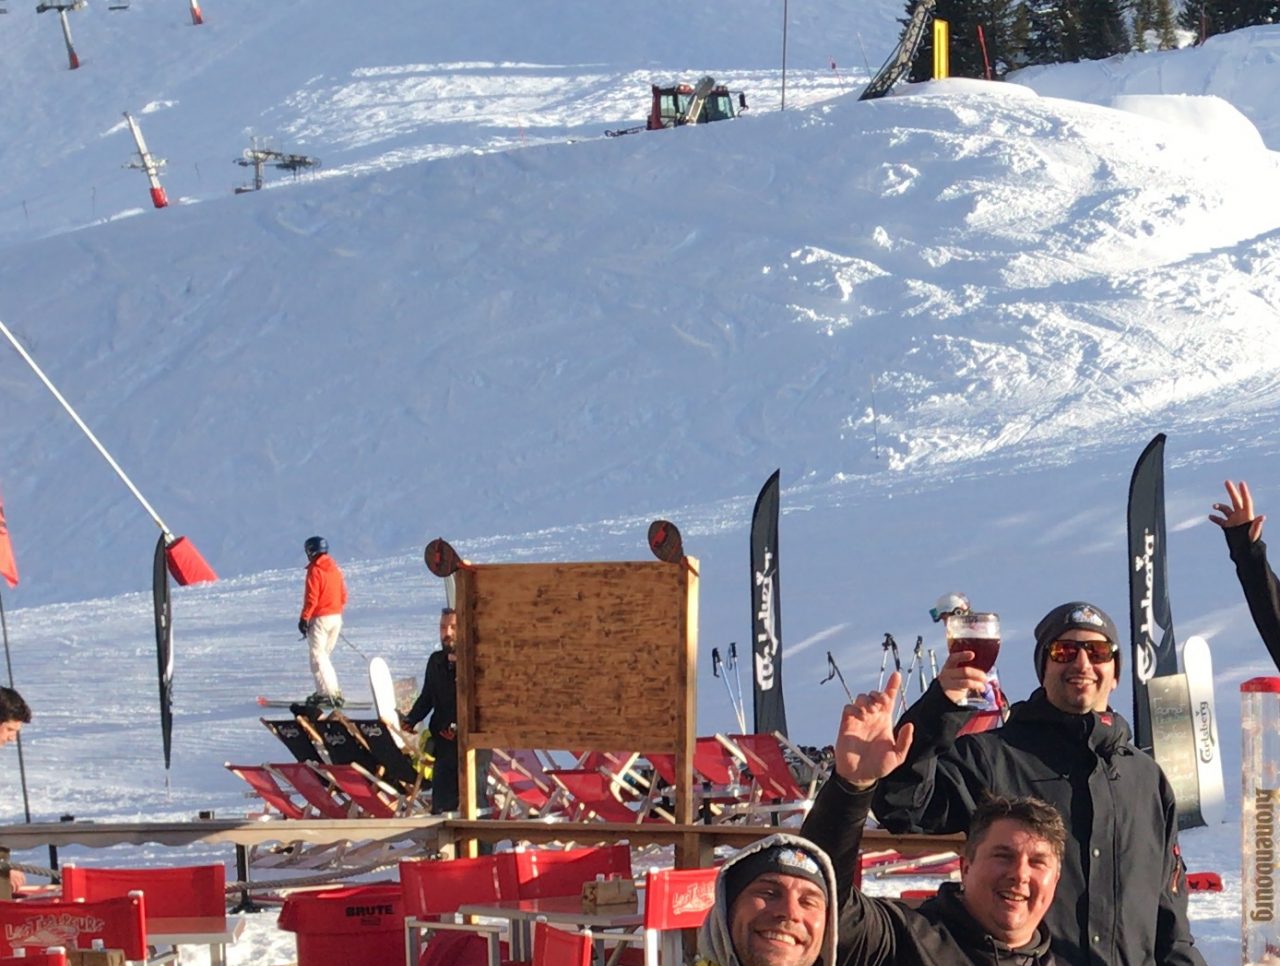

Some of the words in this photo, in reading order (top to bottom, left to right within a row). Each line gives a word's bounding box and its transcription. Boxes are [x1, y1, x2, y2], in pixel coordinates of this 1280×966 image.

[1200, 701, 1214, 764] Carlsberg
[1250, 787, 1280, 922] Kronenbourg
[345, 904, 394, 917] BRUTE
